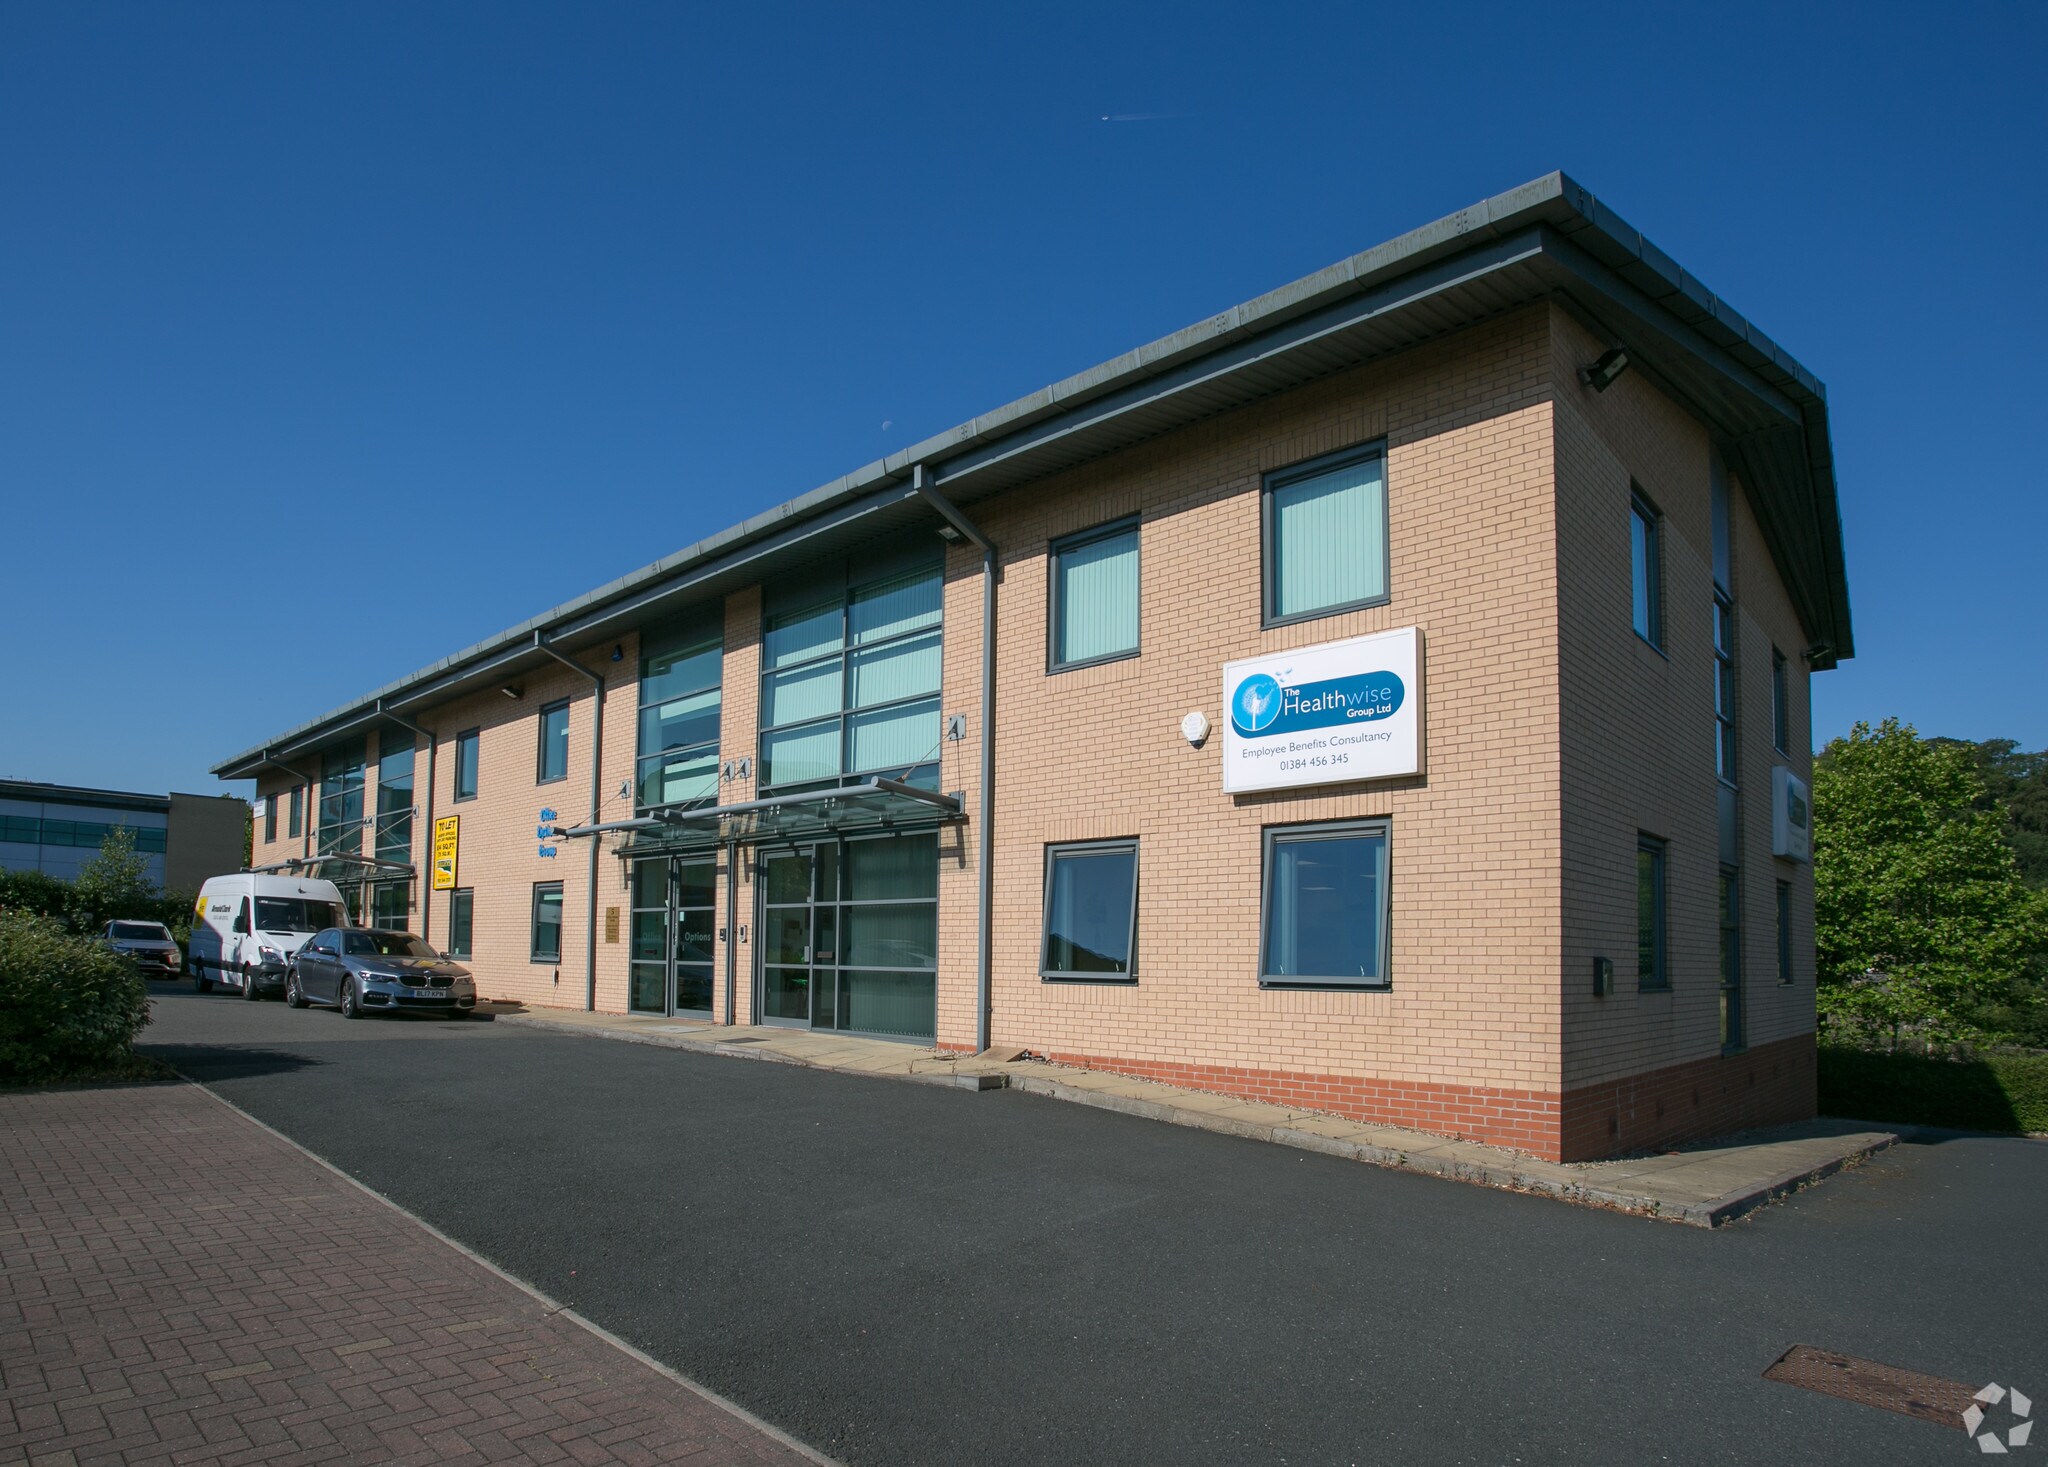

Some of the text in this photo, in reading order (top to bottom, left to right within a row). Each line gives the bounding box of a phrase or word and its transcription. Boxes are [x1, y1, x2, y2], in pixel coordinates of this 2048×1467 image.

[1284, 688, 1300, 697] The
[1284, 685, 1392, 716] Healthwise
[1346, 703, 1392, 718] Group Ltd
[1242, 731, 1392, 759] Employee Benefits Consultancy
[1280, 753, 1349, 771] 01384 456 345
[445, 820, 456, 830] LET
[684, 931, 711, 944] Options
